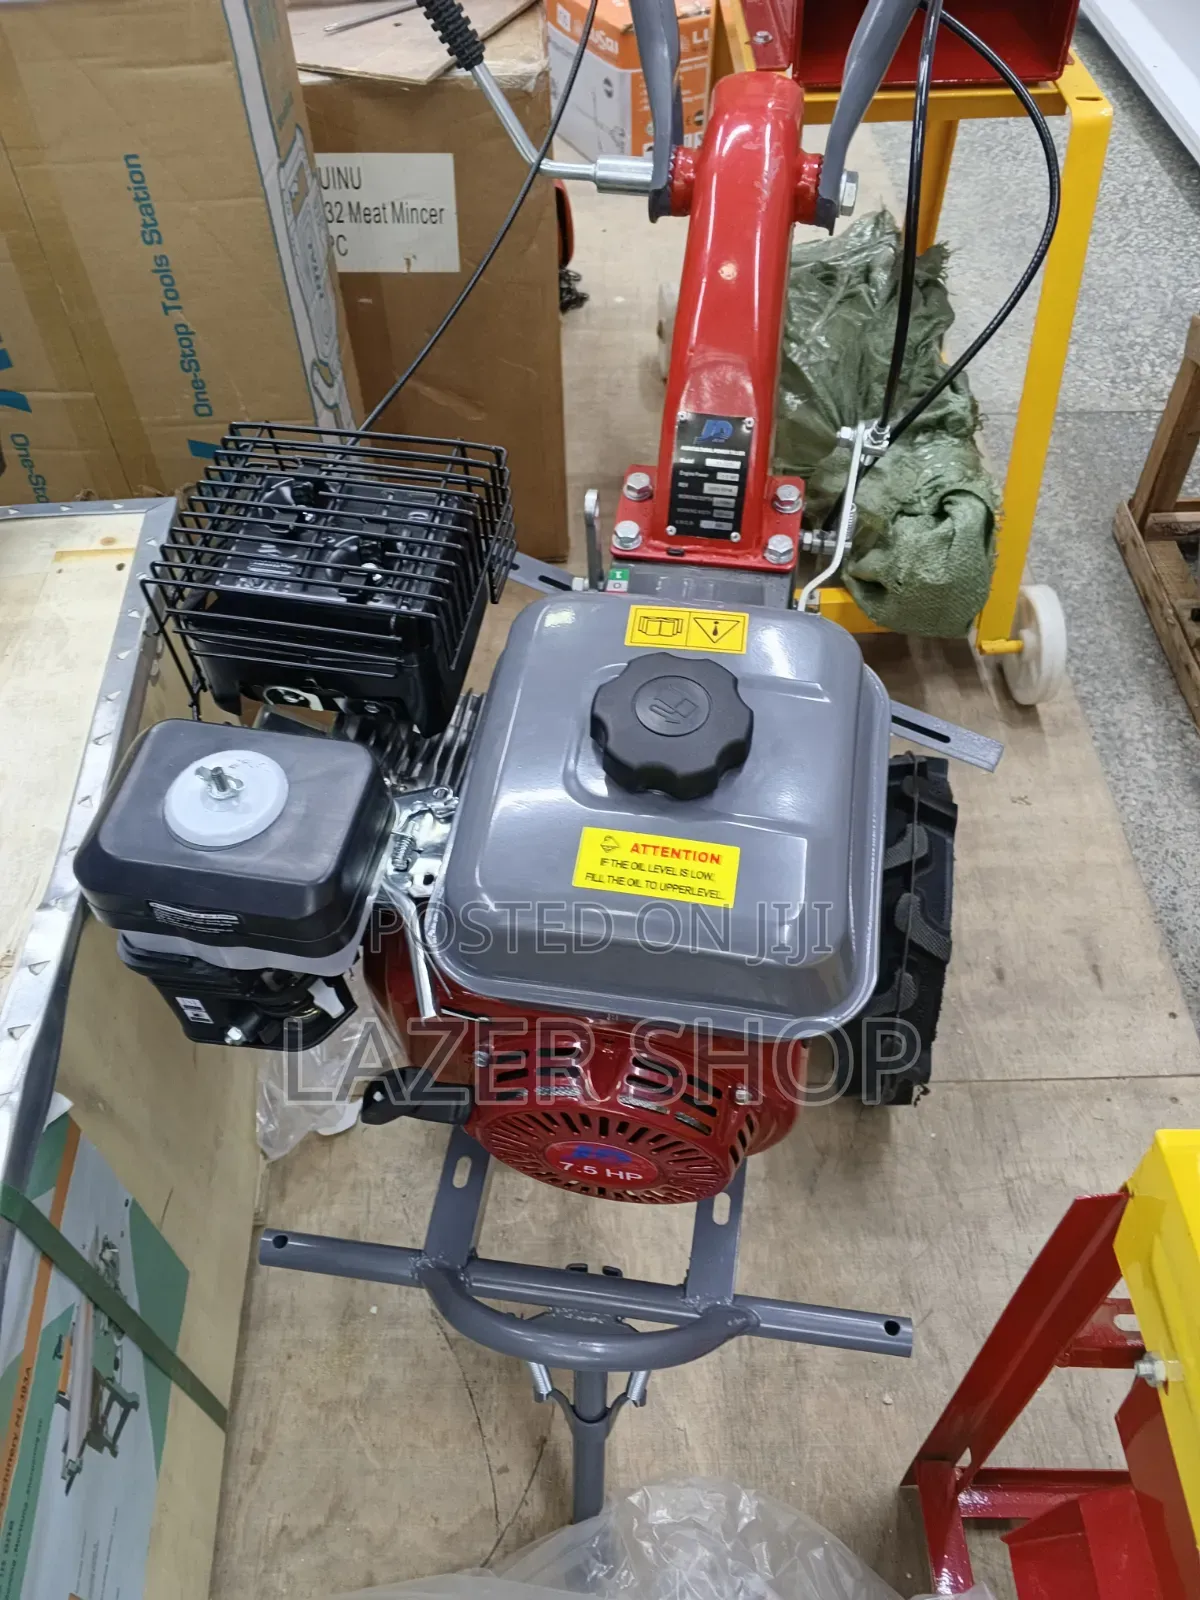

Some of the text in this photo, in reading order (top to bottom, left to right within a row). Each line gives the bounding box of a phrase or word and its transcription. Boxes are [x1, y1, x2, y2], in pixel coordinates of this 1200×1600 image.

[348, 201, 388, 224] Meat
[391, 201, 446, 224] Mincer
[124, 153, 213, 417] One-Stop Tools Station
[630, 843, 722, 865] ATTENTION
[600, 858, 609, 866] IF
[611, 859, 629, 869] THE
[631, 862, 646, 871] OIL
[648, 864, 677, 876] LEVEL
[680, 868, 689, 877] IS
[585, 872, 605, 884] FILL
[607, 875, 626, 886] THE
[627, 878, 642, 887] OIL
[645, 880, 657, 889] TO
[559, 1161, 643, 1180] 7.5 HP
